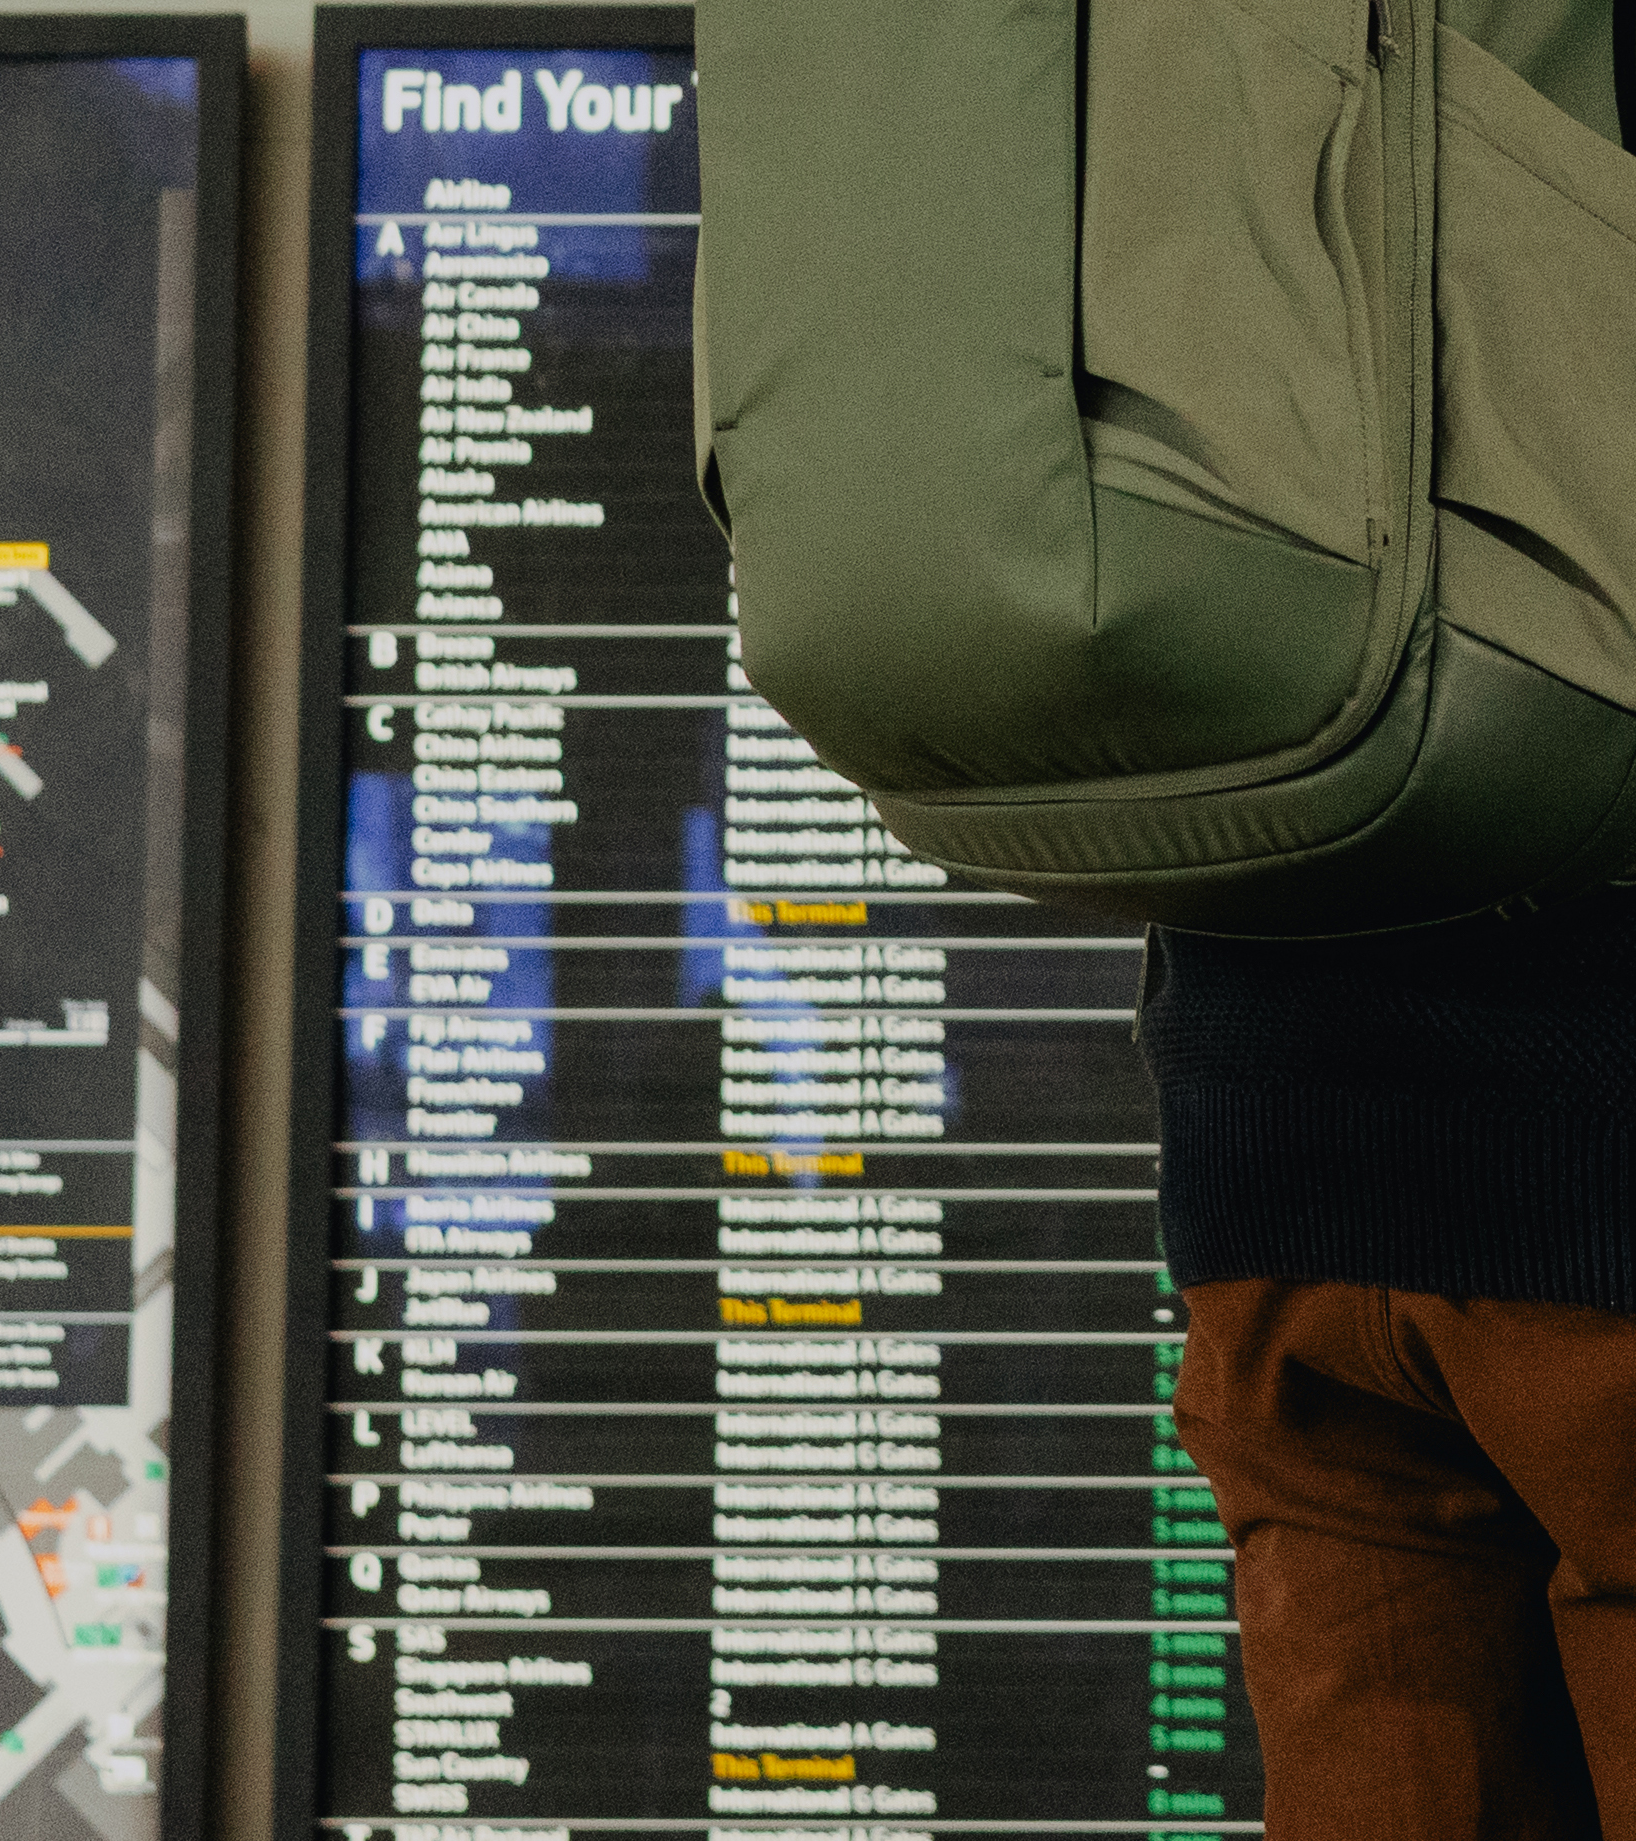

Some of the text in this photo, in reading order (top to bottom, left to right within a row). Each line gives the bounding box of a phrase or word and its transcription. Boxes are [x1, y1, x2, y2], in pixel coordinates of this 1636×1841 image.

[384, 69, 682, 132] Find Your
[377, 222, 404, 255] A
[367, 706, 396, 742] C
[367, 899, 396, 934] D
[359, 1151, 390, 1184] H
